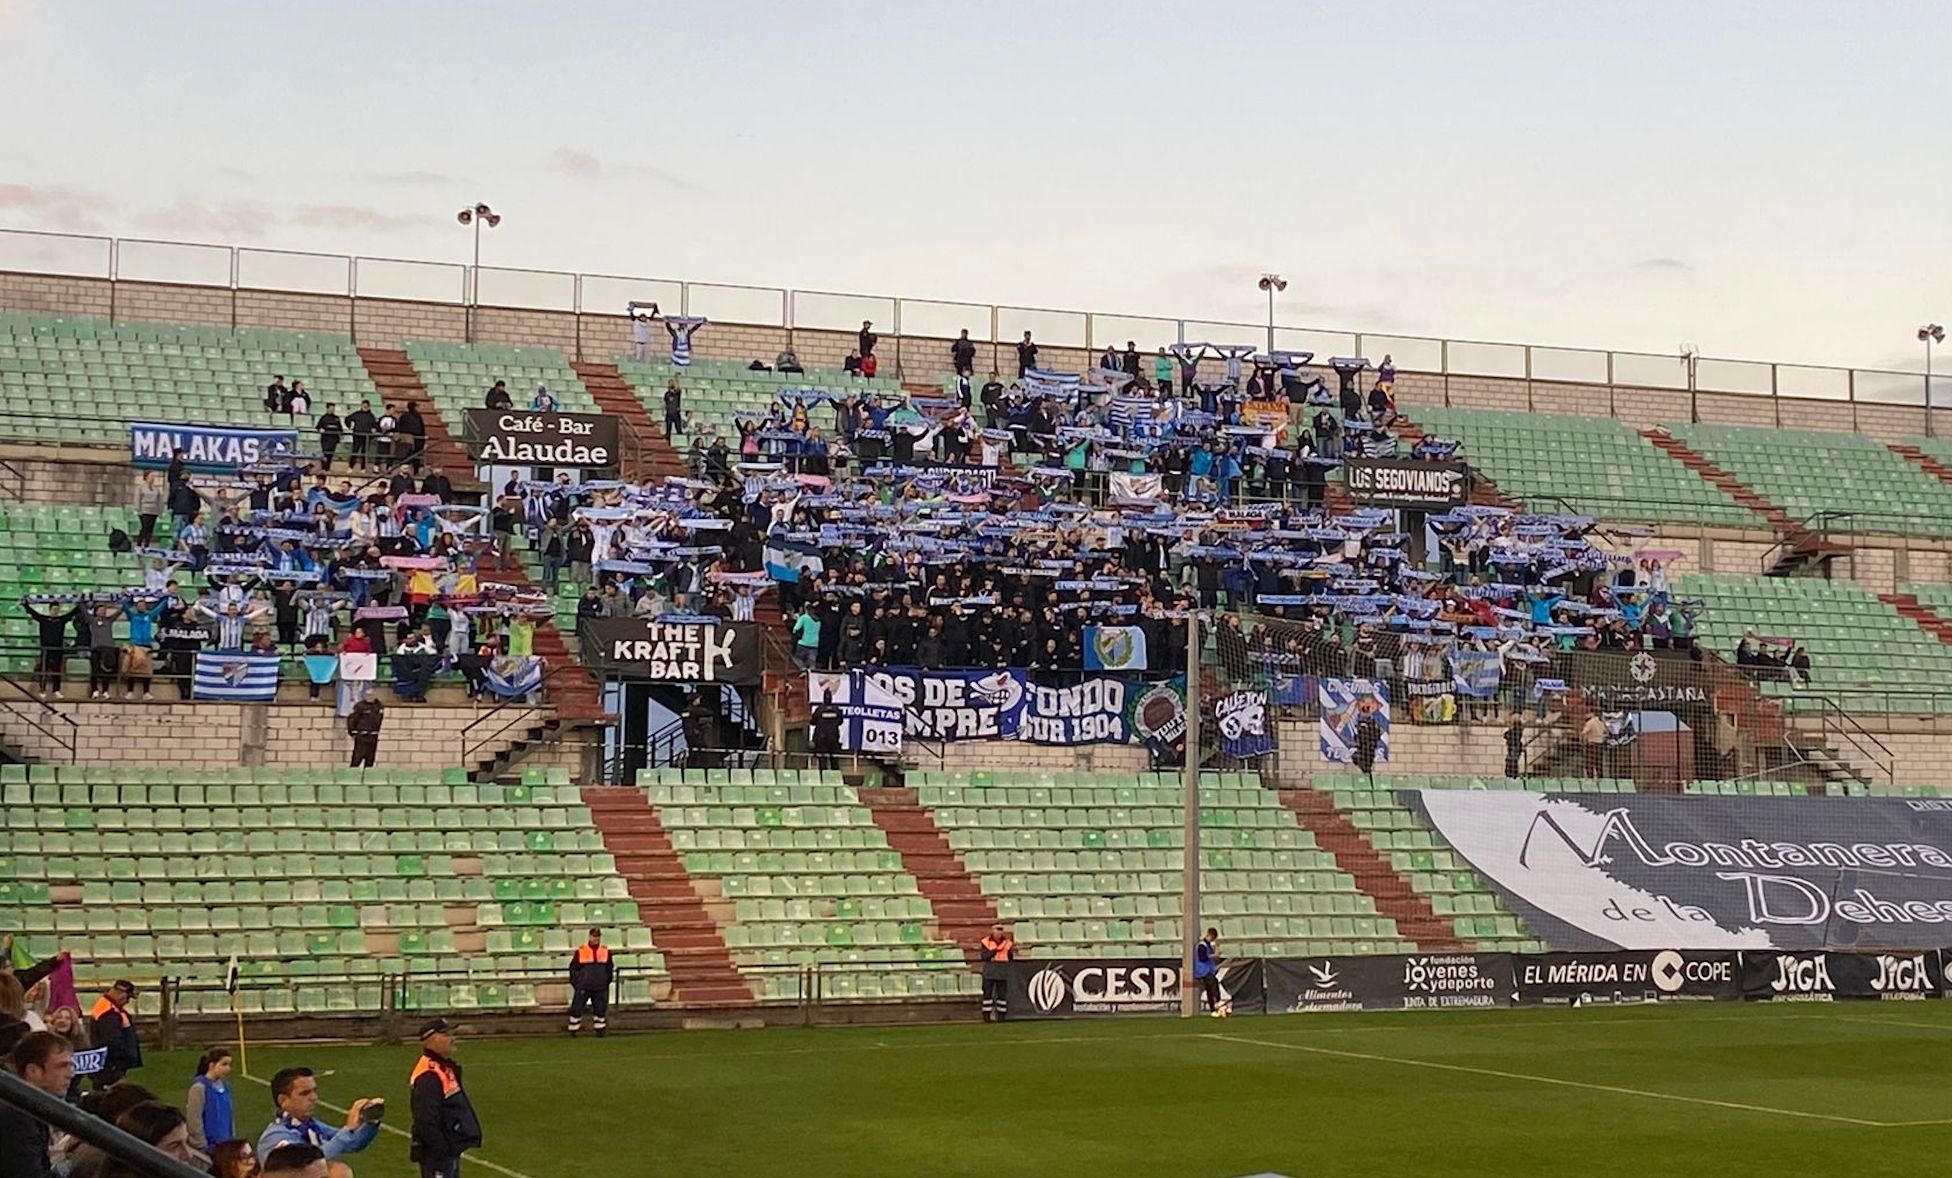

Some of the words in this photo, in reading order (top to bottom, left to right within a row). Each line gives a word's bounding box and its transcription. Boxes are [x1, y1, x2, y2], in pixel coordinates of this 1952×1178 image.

[499, 415, 543, 432] Café
[559, 418, 594, 434] Bar
[134, 430, 260, 463] MALAKAS
[480, 436, 608, 464] Alaudae
[1350, 467, 1373, 488] LOS
[1375, 468, 1450, 493] SEGOVIANOS
[647, 623, 699, 641] THE
[614, 641, 701, 660] KRAFT
[650, 661, 699, 679] BAR
[872, 672, 915, 705] OS
[924, 678, 966, 707] DE
[866, 729, 898, 746] 013
[1072, 713, 1122, 741] 1904
[1602, 898, 1656, 922] de
[1660, 896, 1714, 922] la
[1430, 956, 1475, 965] fundación
[1524, 965, 1543, 984] EL
[1548, 960, 1619, 983] MÉRIDA
[1623, 964, 1647, 981] EN
[1686, 961, 1731, 981] COPE
[1404, 997, 1425, 1009] JUNTA
[1428, 997, 1437, 1007] DE
[1440, 995, 1495, 1007] EXTREMADURA
